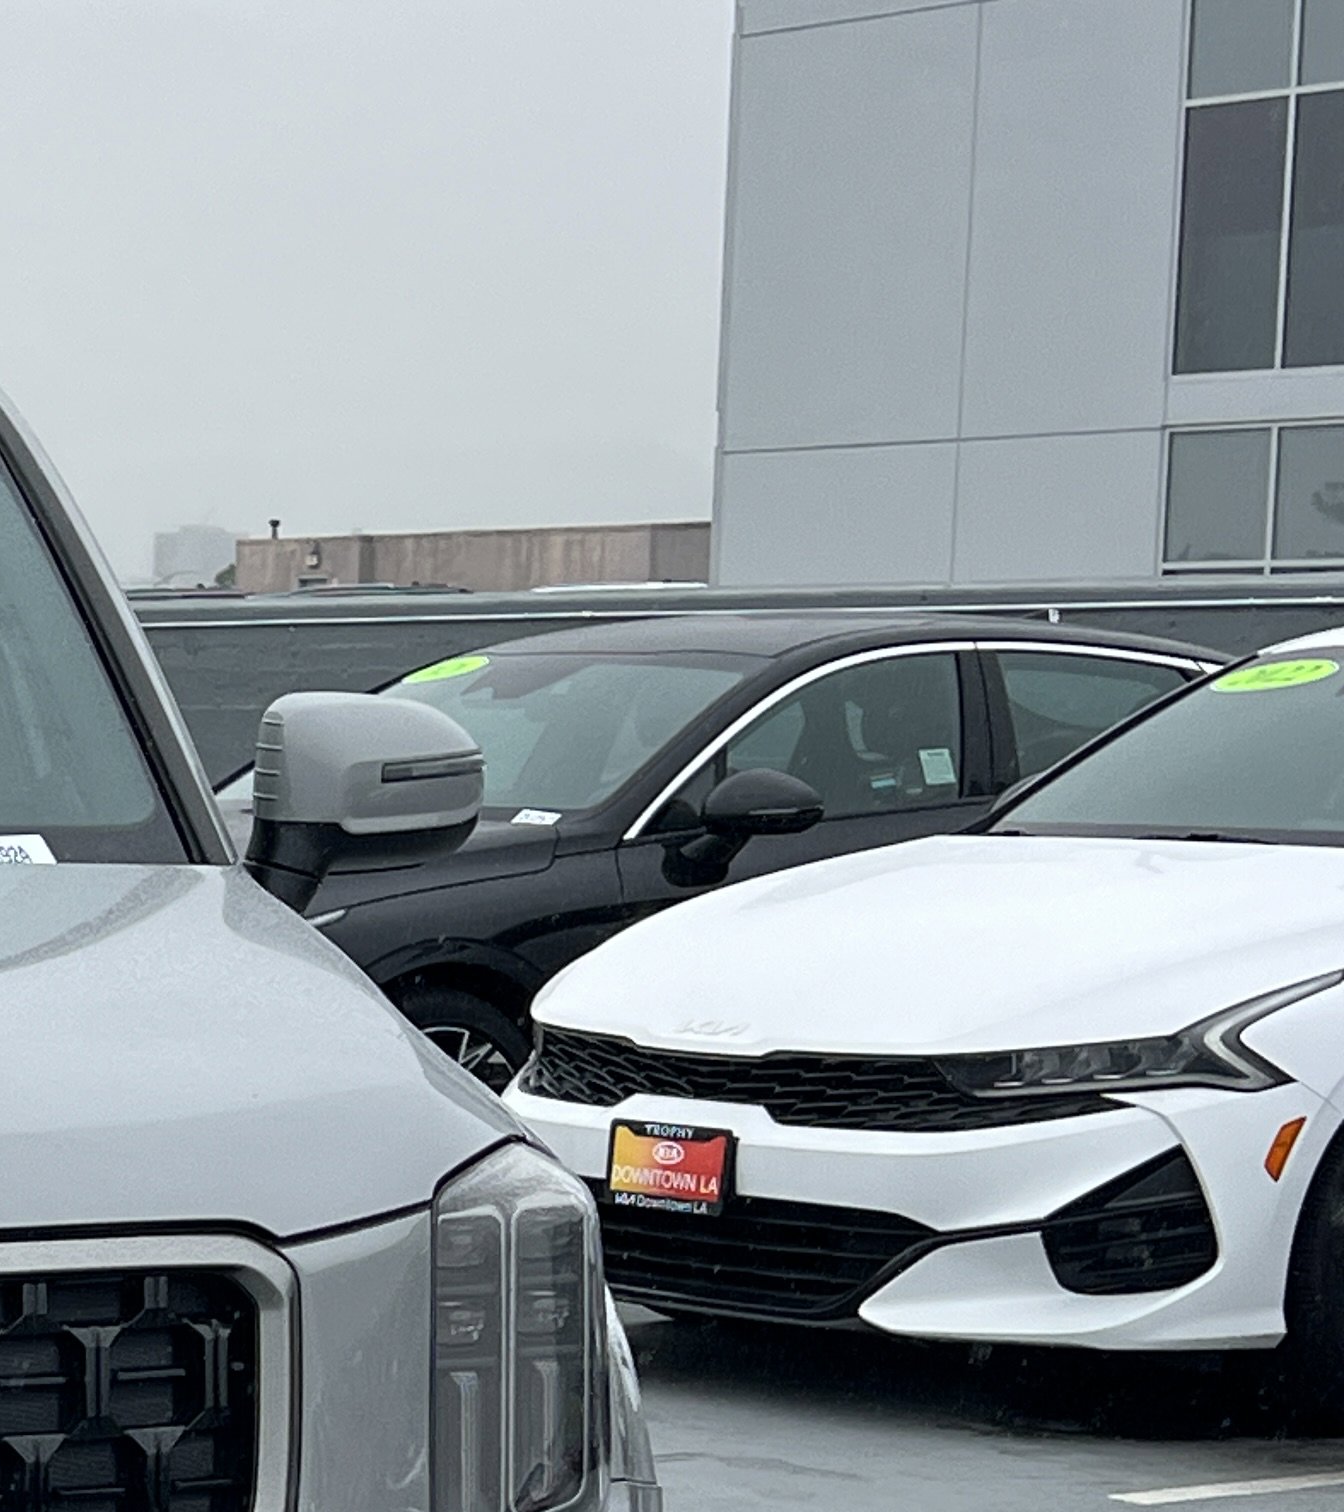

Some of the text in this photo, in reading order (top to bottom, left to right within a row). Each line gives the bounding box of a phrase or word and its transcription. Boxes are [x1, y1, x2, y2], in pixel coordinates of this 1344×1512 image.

[644, 1124, 695, 1139] TROPHY
[612, 1164, 718, 1195] DOWNTOWN LA
